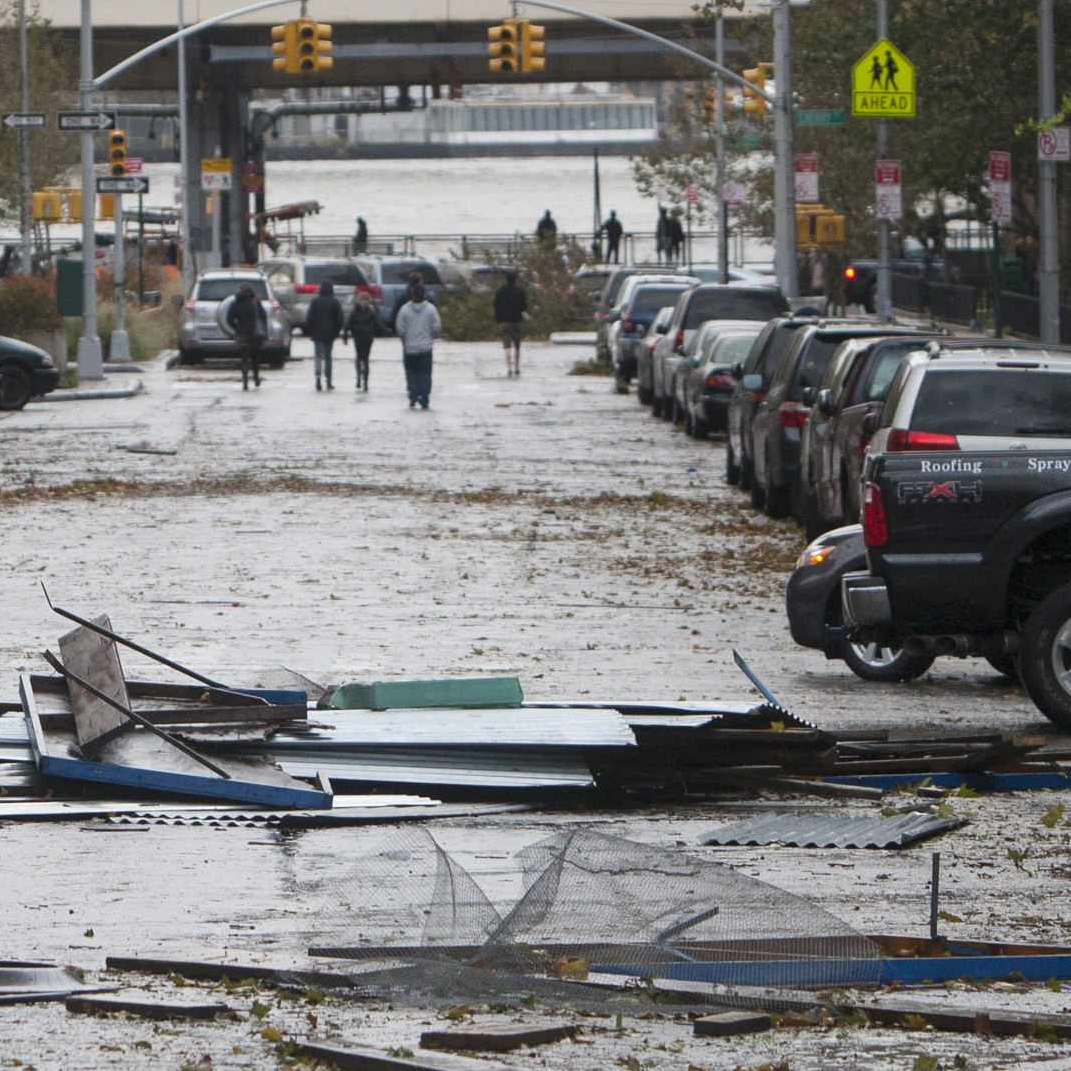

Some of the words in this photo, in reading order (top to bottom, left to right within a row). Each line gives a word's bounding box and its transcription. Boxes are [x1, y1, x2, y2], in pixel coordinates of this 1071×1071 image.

[860, 96, 908, 109] AHEAD
[65, 116, 82, 125] ONE
[921, 459, 983, 473] Roofing
[1028, 457, 1071, 473] Spray
